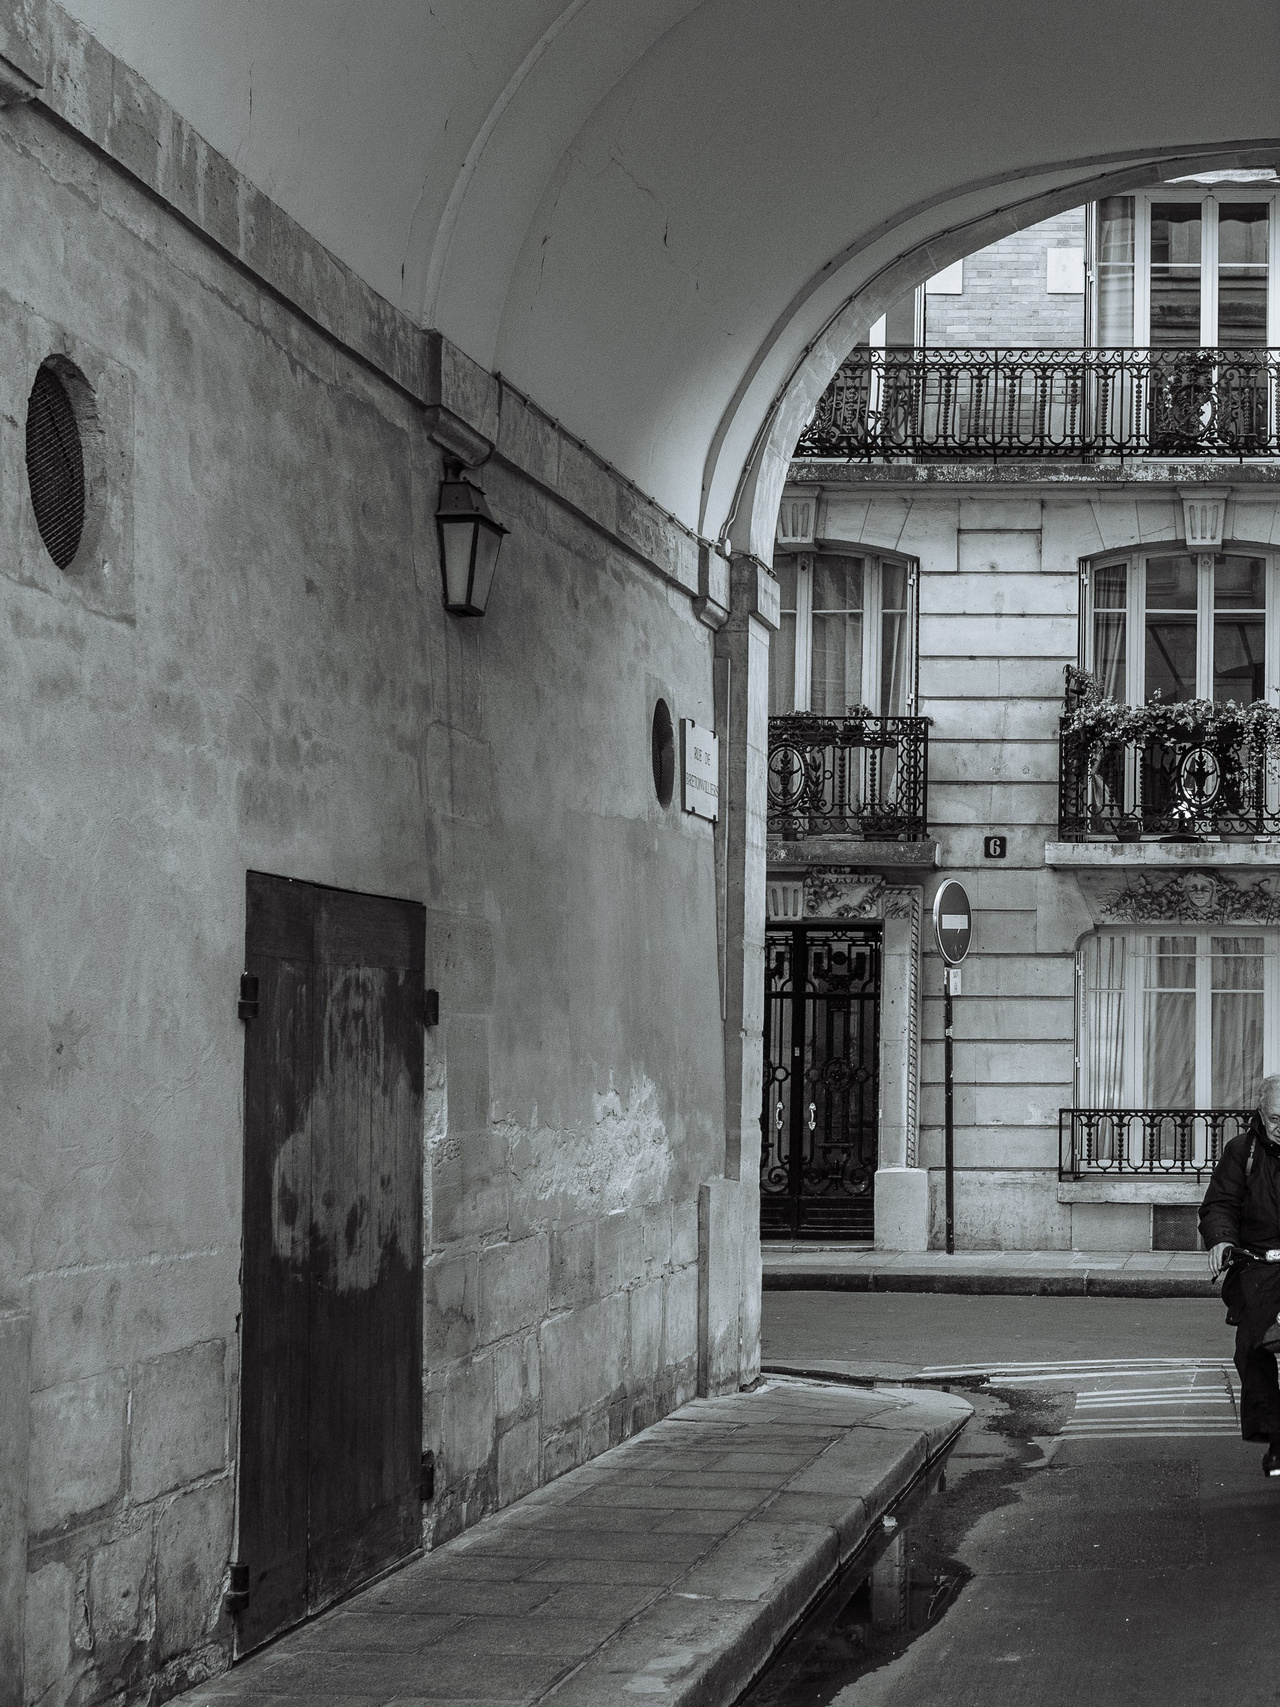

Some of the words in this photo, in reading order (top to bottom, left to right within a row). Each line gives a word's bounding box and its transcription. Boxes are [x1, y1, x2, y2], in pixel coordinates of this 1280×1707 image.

[694, 747, 702, 762] RUE
[705, 752, 711, 766] DE
[990, 838, 1001, 856] 6
